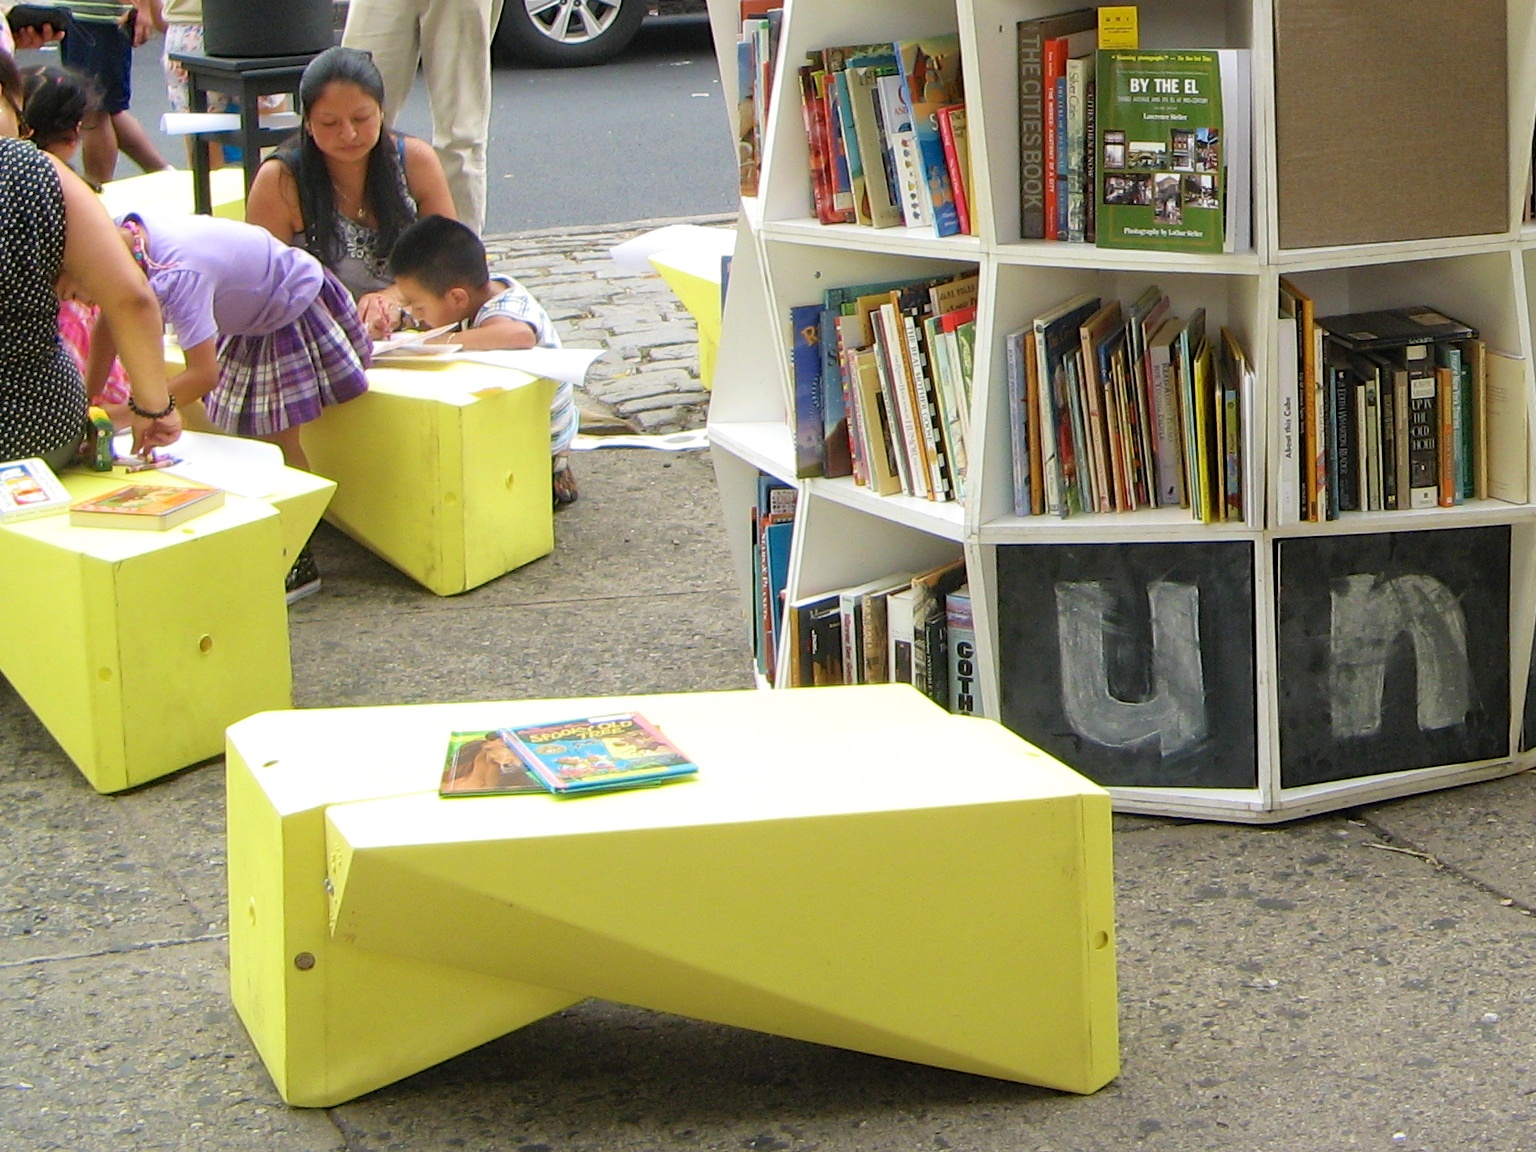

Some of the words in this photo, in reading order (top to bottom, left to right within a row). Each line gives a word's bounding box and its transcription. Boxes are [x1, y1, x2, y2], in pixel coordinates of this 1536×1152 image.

[1021, 34, 1042, 76] THE
[1129, 78, 1150, 93] BY
[1153, 78, 1180, 94] THE
[1183, 79, 1199, 95] EL
[1022, 80, 1042, 147] CITIES
[1023, 150, 1043, 210] BOOK
[1123, 227, 1159, 237] Photography
[1160, 229, 1167, 238] by
[905, 324, 918, 344] THE
[909, 346, 921, 368] REAL
[913, 372, 929, 409] MOTHER
[1411, 399, 1424, 410] UP
[920, 412, 933, 441] GOOSE
[1412, 412, 1427, 424] THE
[1411, 425, 1430, 438] OLD
[1411, 438, 1436, 450] HOTEL
[1328, 572, 1471, 739] n
[957, 641, 976, 714] GOTH
[529, 726, 594, 743] SPOOKY
[597, 720, 633, 729] OLD
[577, 727, 624, 739] TREE
